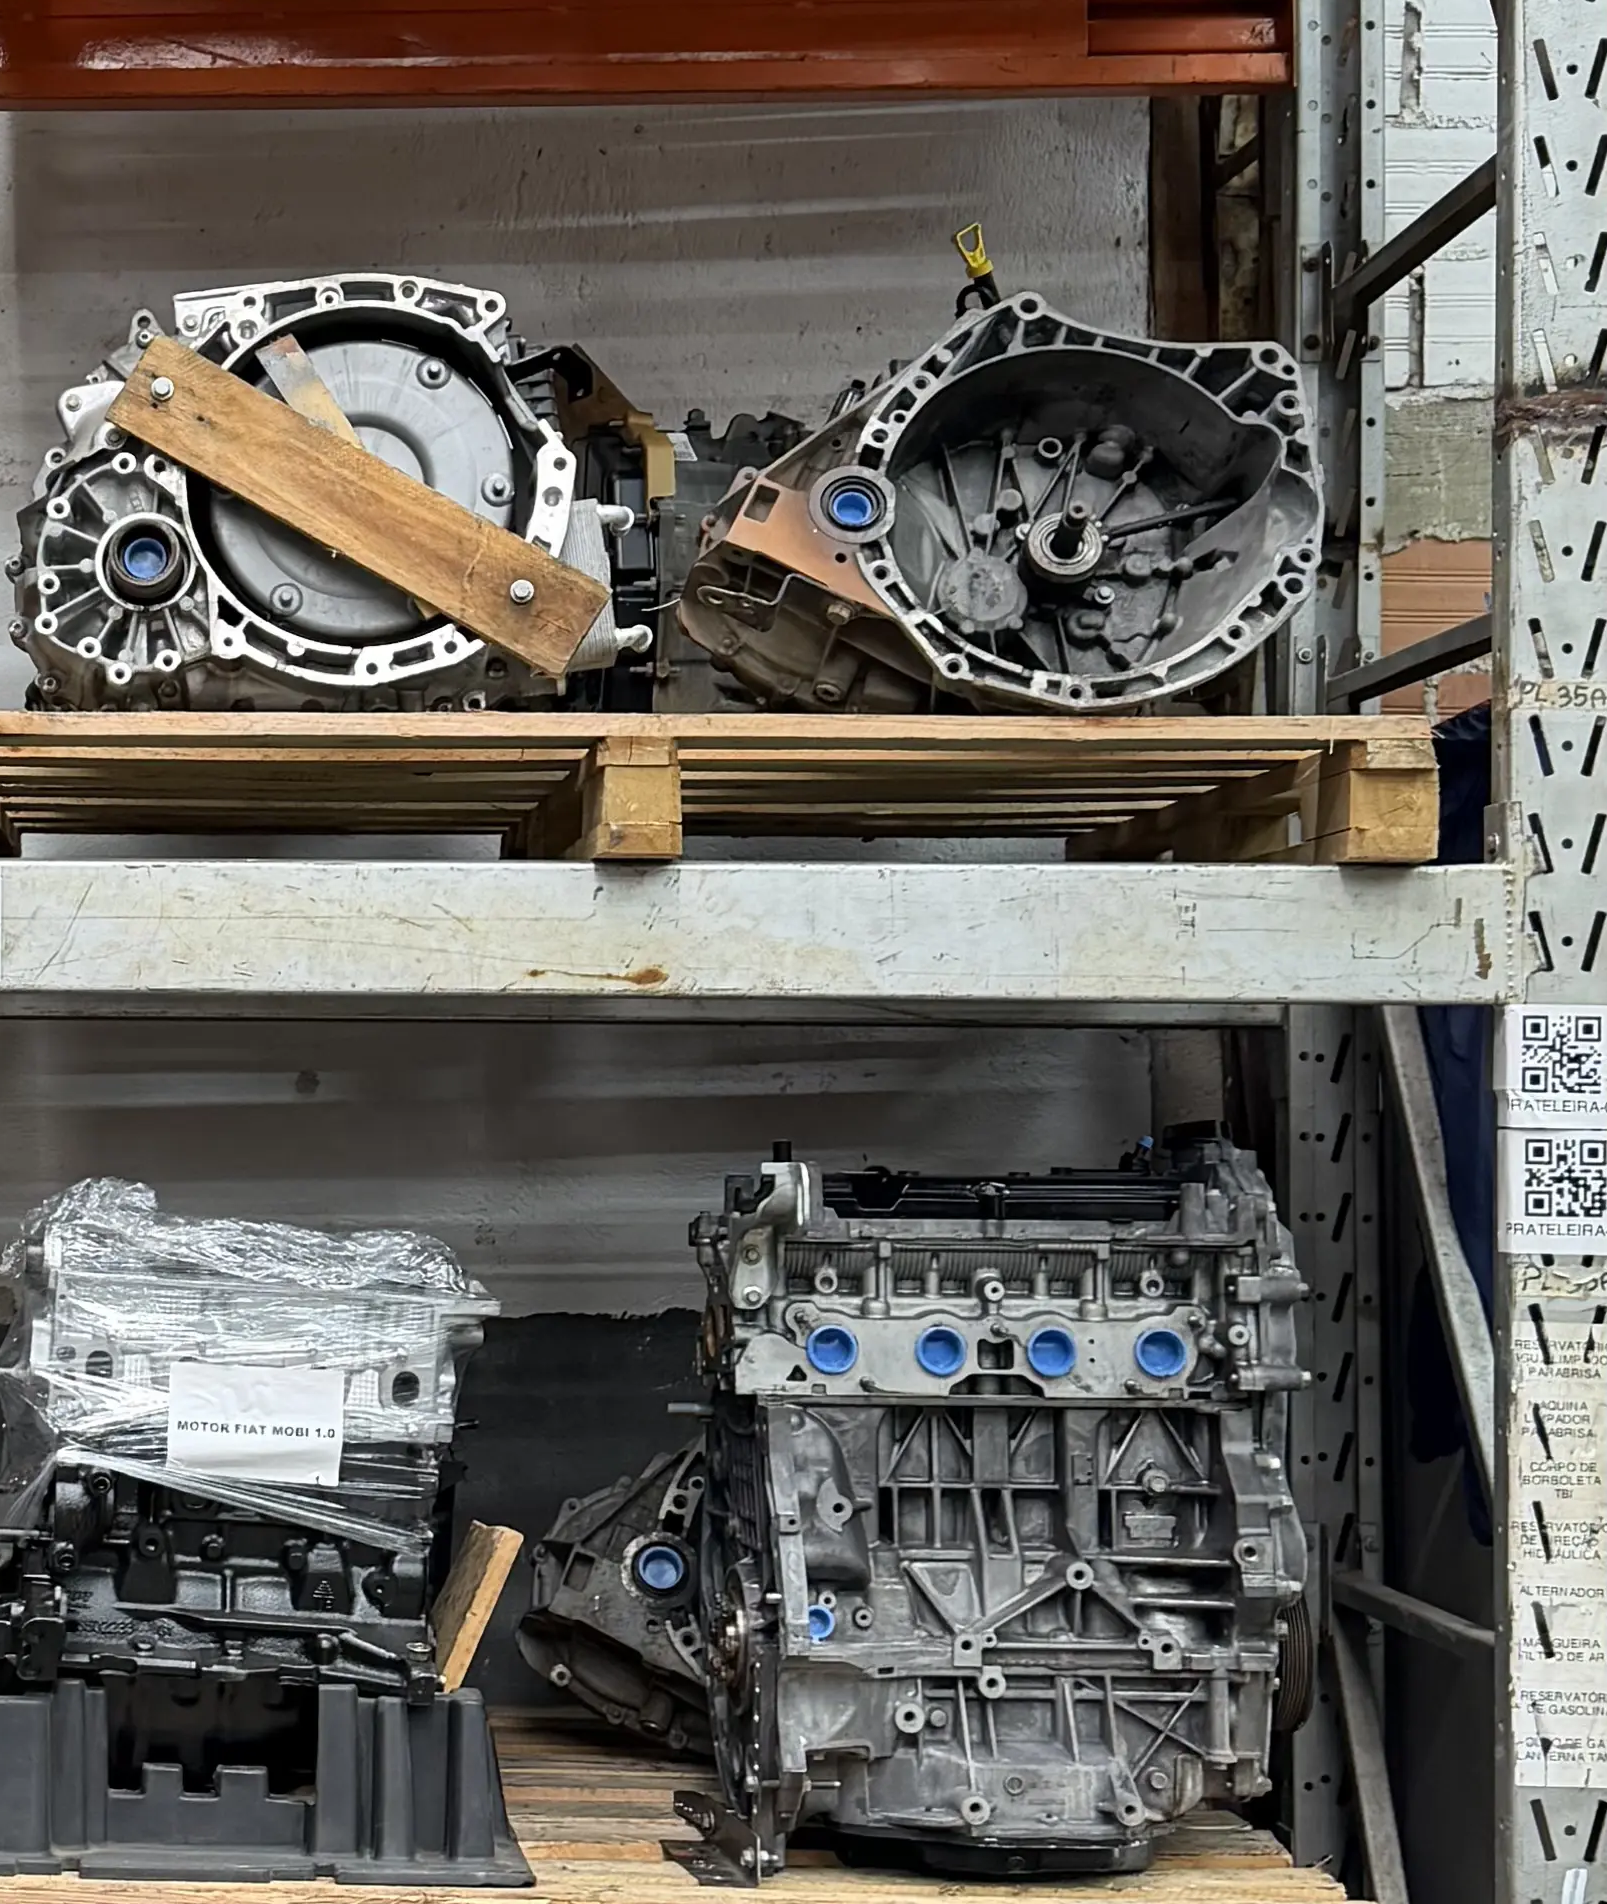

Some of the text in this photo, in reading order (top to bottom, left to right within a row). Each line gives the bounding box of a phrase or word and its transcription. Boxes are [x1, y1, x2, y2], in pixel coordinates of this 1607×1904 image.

[1524, 1413, 1591, 1425] LPADOR
[176, 1419, 336, 1439] MOTOR FIAT MOBI 1.0
[1521, 1427, 1596, 1438] PAABRISA
[1580, 1462, 1597, 1473] DE
[1519, 1585, 1604, 1598] ALTERNADOR
[1522, 1637, 1601, 1649] MAGUEIRA
[1518, 1650, 1605, 1663] FILTO DE AR
[1549, 1704, 1607, 1716] GASOLIN
[1517, 1750, 1585, 1763] LANERNA
